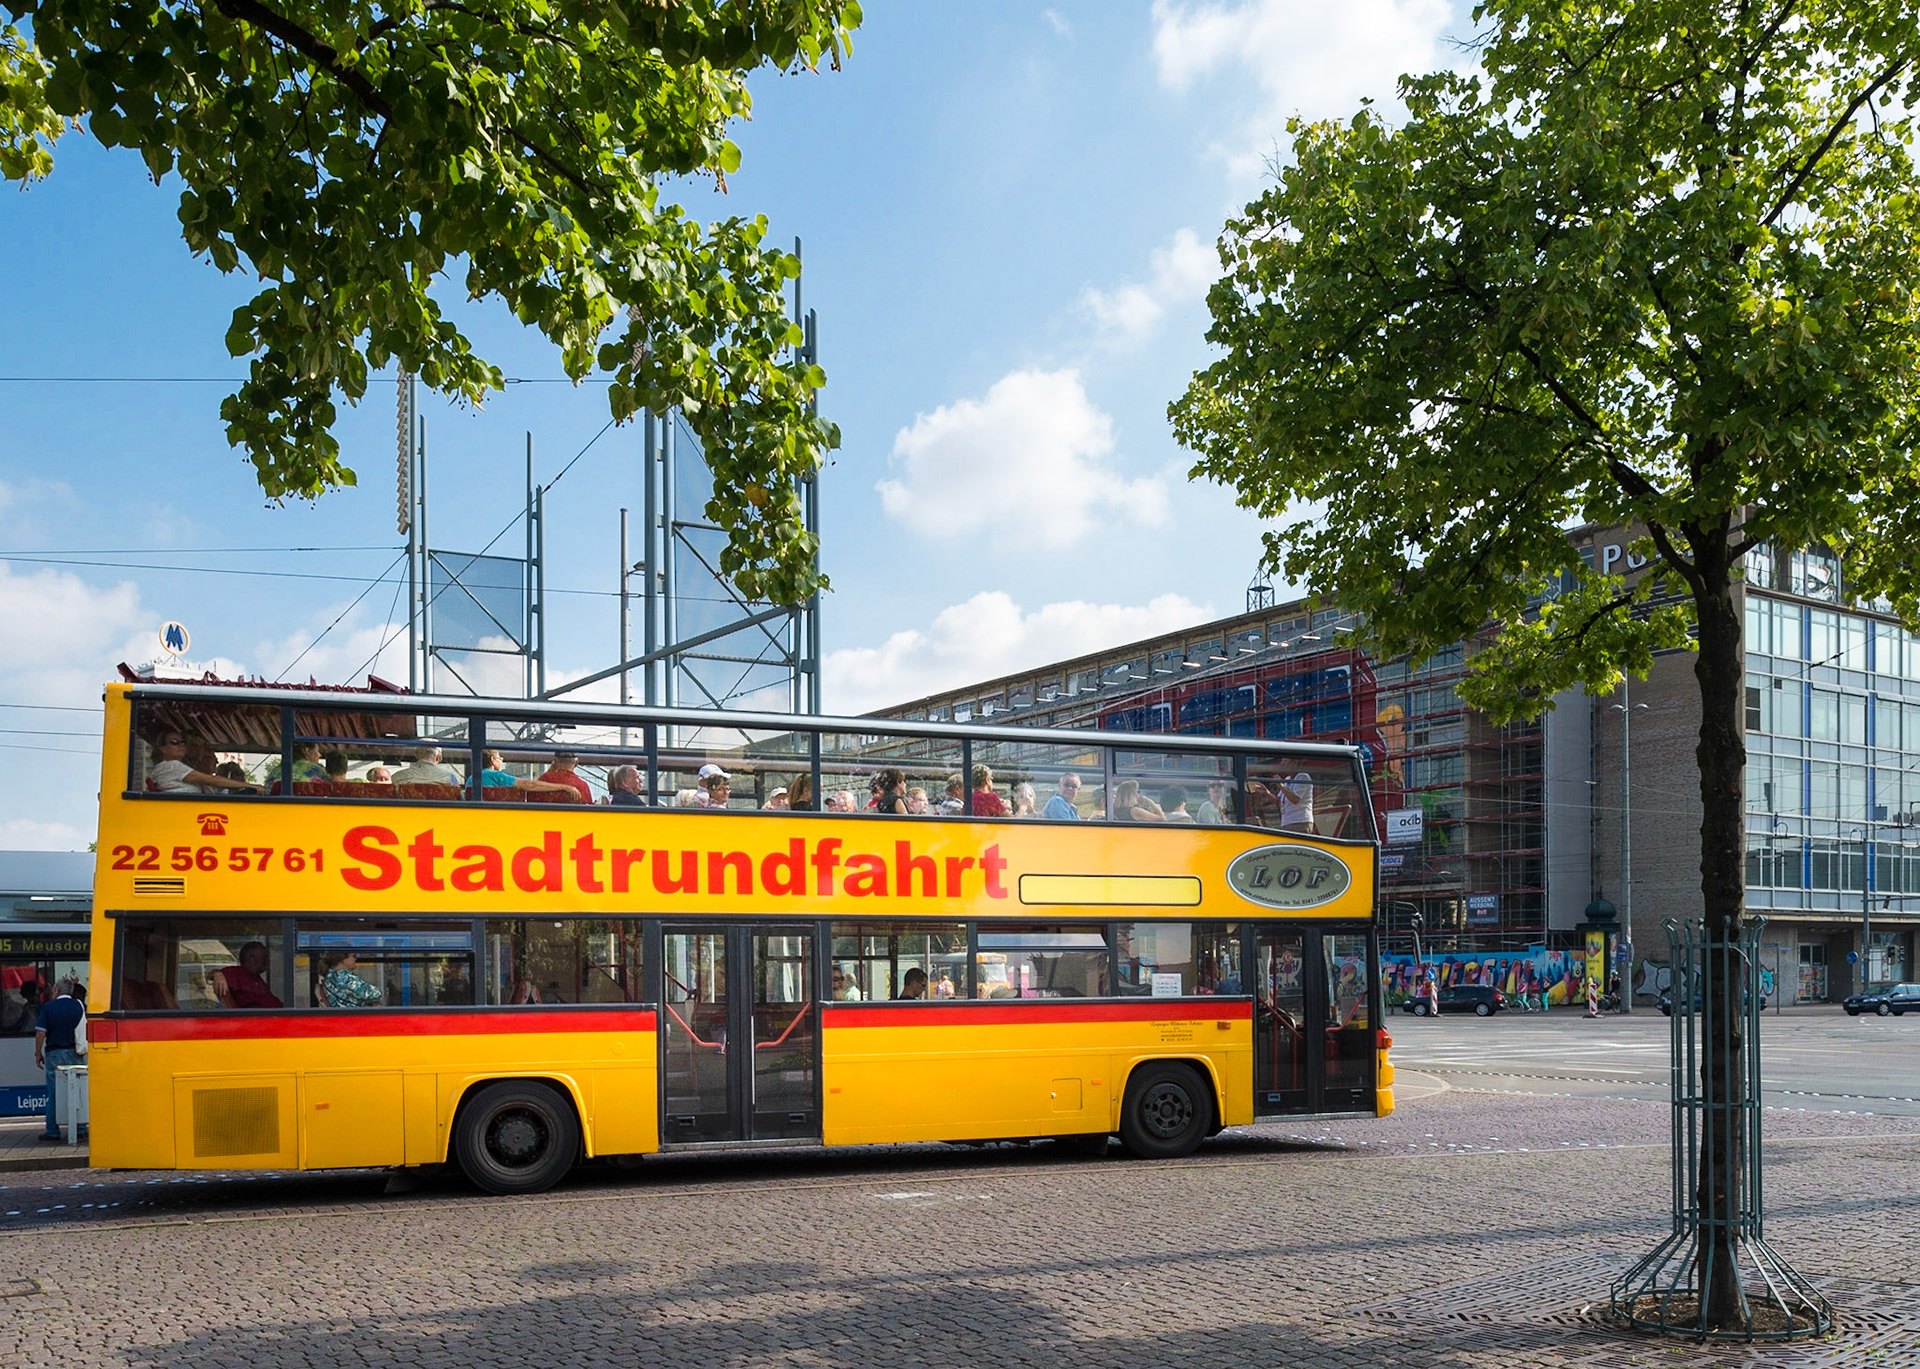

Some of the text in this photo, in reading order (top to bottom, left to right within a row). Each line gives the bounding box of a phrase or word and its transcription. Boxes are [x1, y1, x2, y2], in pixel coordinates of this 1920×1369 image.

[111, 845, 323, 872] 22 56 57 61
[340, 825, 1008, 899] Stadtrundfahrt
[17, 1094, 49, 1111] Leipzi
